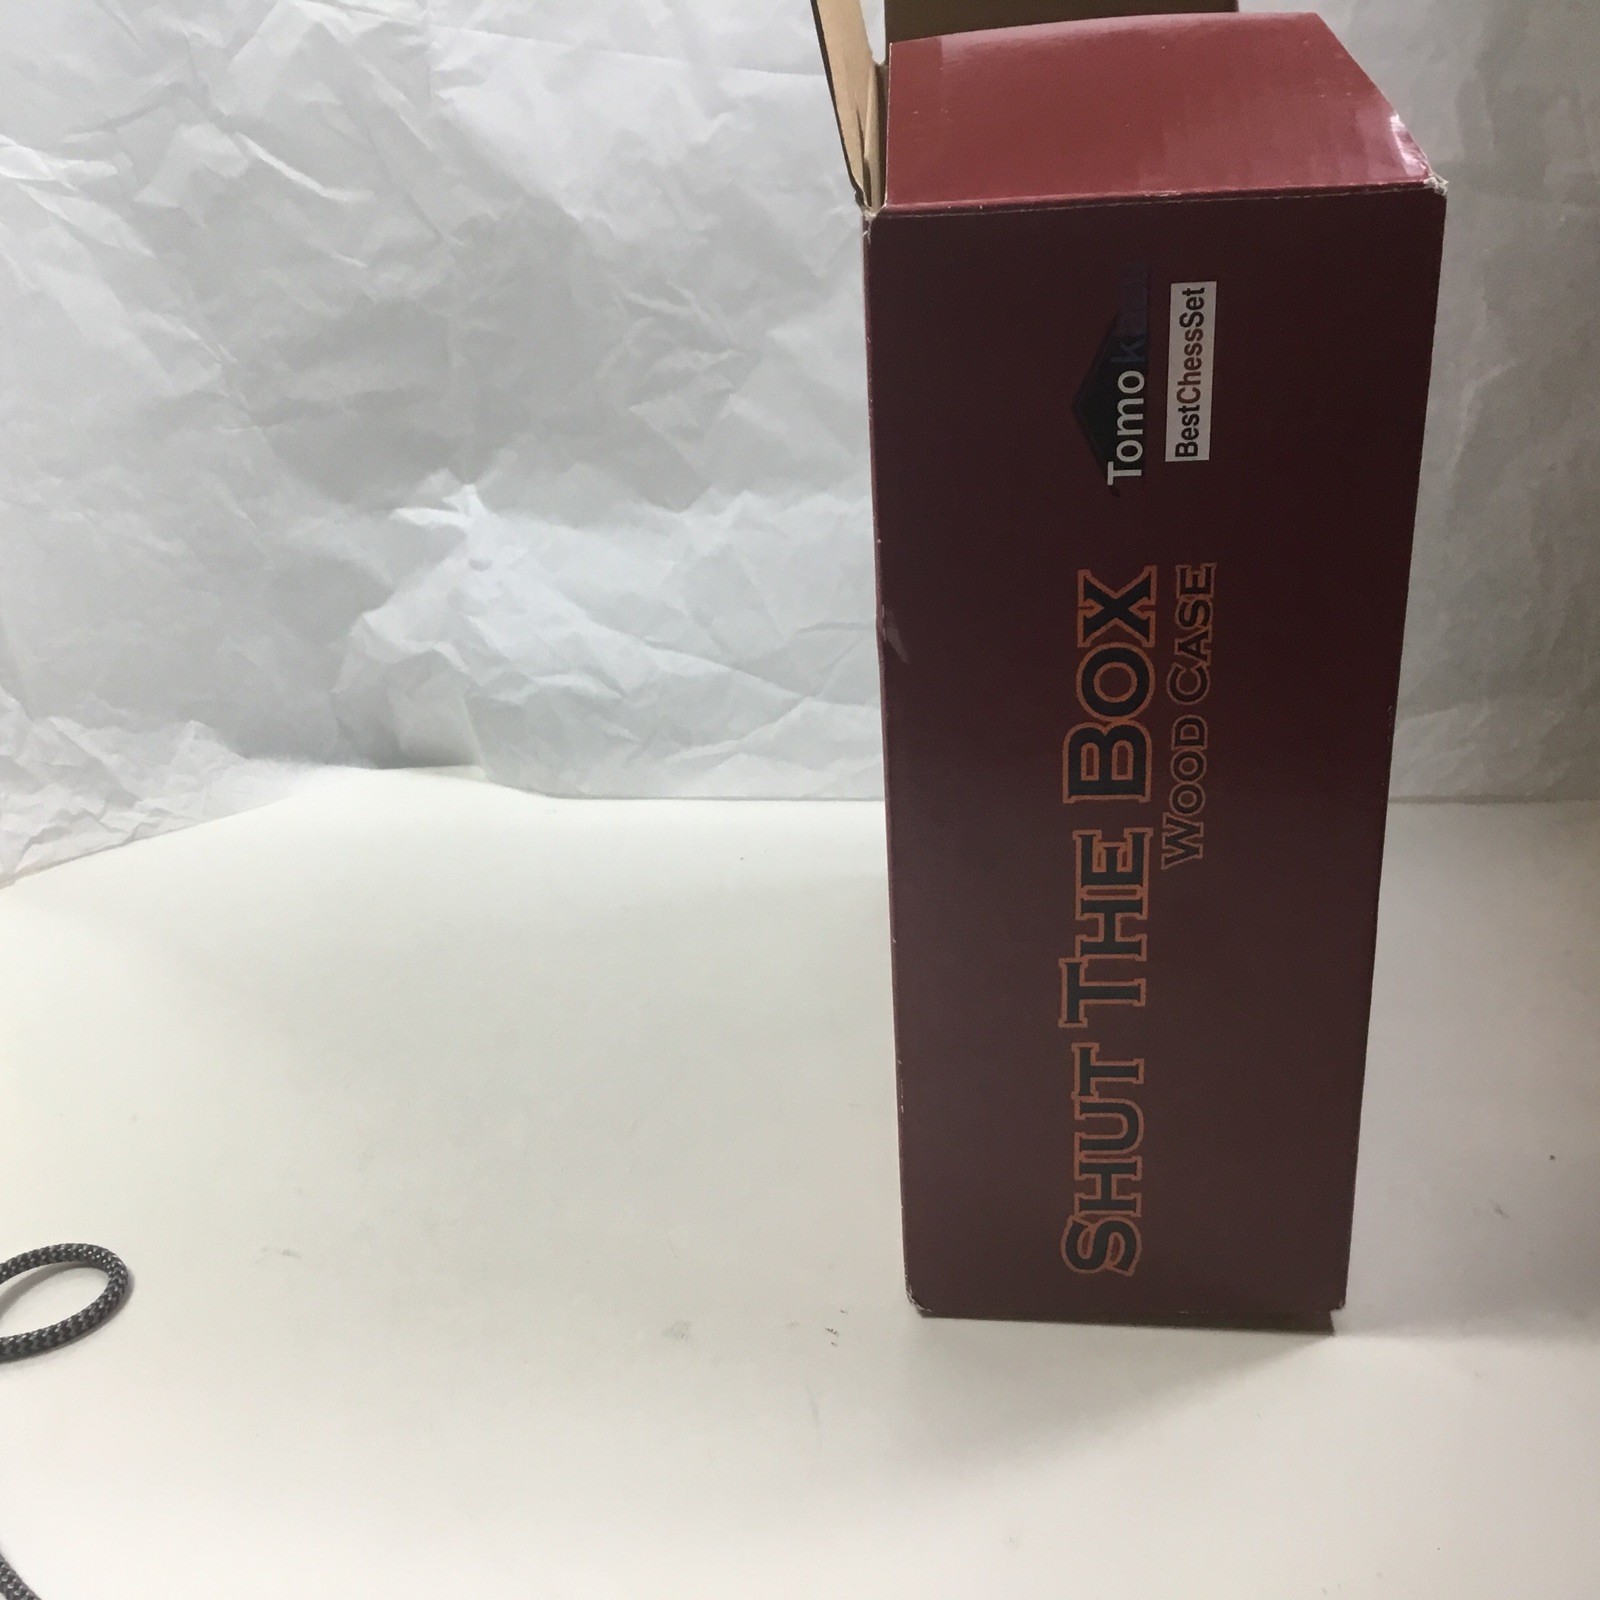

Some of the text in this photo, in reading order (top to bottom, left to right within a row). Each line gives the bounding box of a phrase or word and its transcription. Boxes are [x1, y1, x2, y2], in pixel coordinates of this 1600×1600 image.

[1174, 287, 1206, 457] BestChessSet
[1161, 562, 1217, 870] WOOD CASE
[1058, 565, 1157, 1277] SHUT THE BOX
